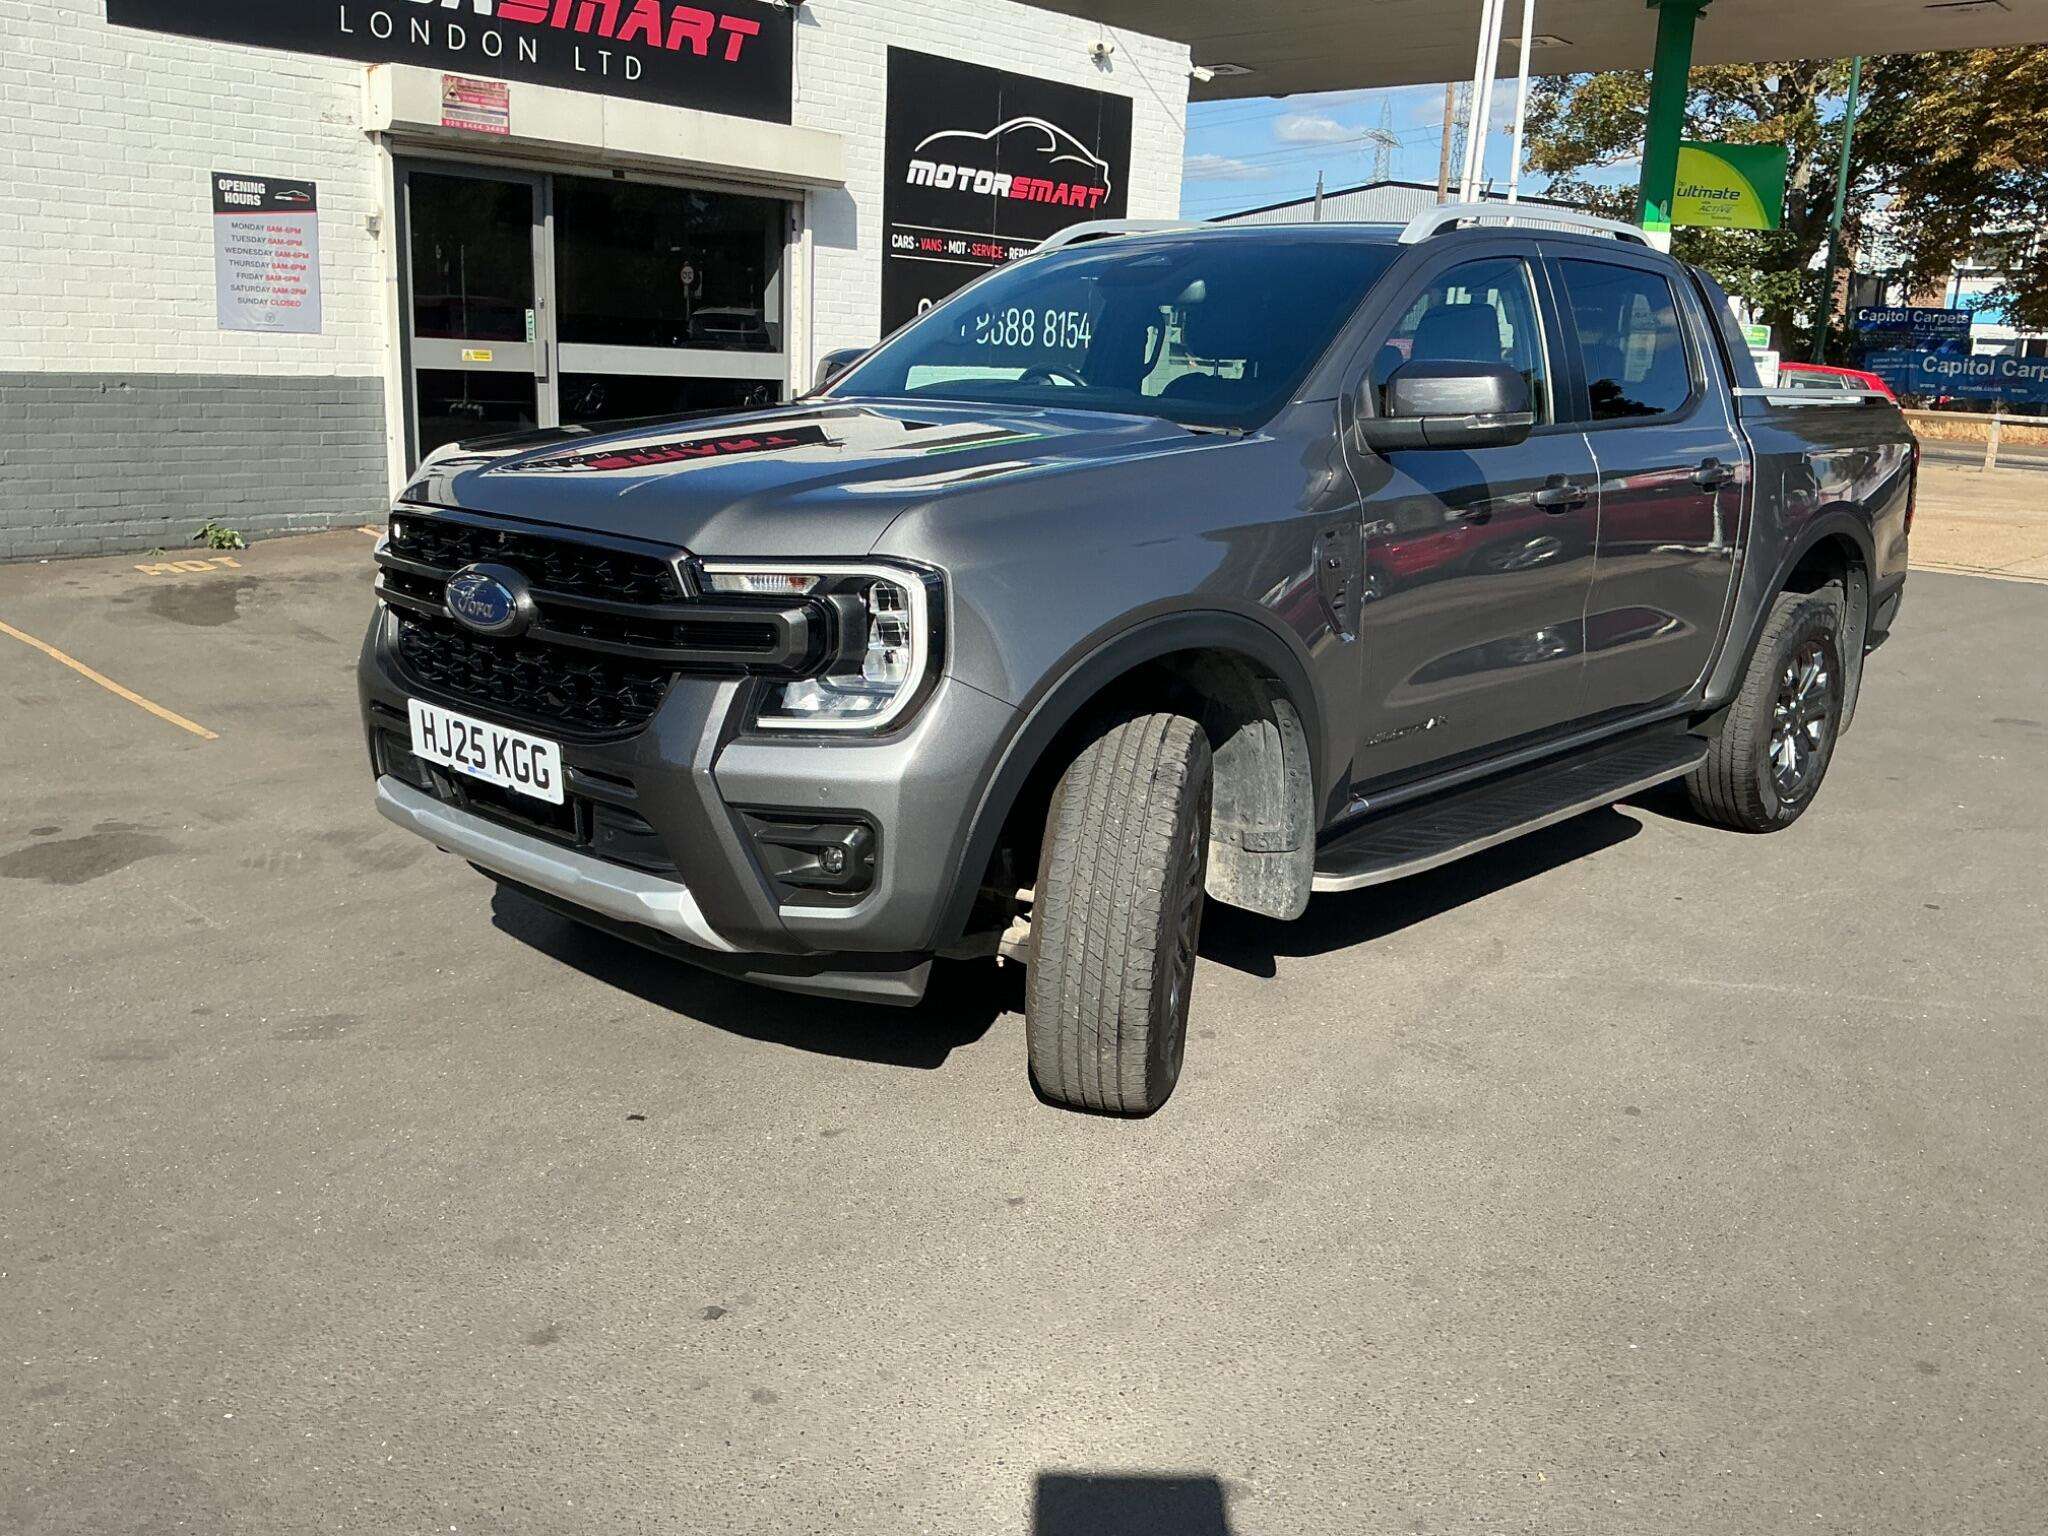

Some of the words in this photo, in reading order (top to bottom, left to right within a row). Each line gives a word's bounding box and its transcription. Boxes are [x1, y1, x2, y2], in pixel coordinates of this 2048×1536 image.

[339, 5, 538, 63] LONDON
[575, 46, 642, 80] LTD
[218, 179, 266, 195] OPENING
[906, 159, 1105, 209] MOTORSMART
[224, 192, 262, 207] HOURS
[1676, 185, 1741, 201] ultimate
[231, 222, 265, 232] MONDAY
[231, 235, 266, 243] TUESDAY
[891, 234, 915, 250] CARS
[920, 237, 943, 252] VANS
[948, 240, 967, 255] MOT
[971, 242, 1004, 259] SERVICE
[225, 247, 273, 257] WEDNESDAY
[229, 260, 270, 269] THURSDAY
[236, 272, 264, 280] FRIDAY
[230, 284, 271, 293] SATURDAY
[237, 297, 268, 305] SUNDAY
[270, 299, 302, 308] CLOSED
[1859, 309, 1909, 325] Capitol
[1912, 310, 1970, 326] Carpets
[1043, 309, 1092, 349] 8154
[1922, 356, 1996, 377] Capitol
[134, 556, 242, 576] MOT
[457, 586, 495, 618] Ford
[420, 709, 487, 770] HJ25
[492, 731, 551, 790] KGG
